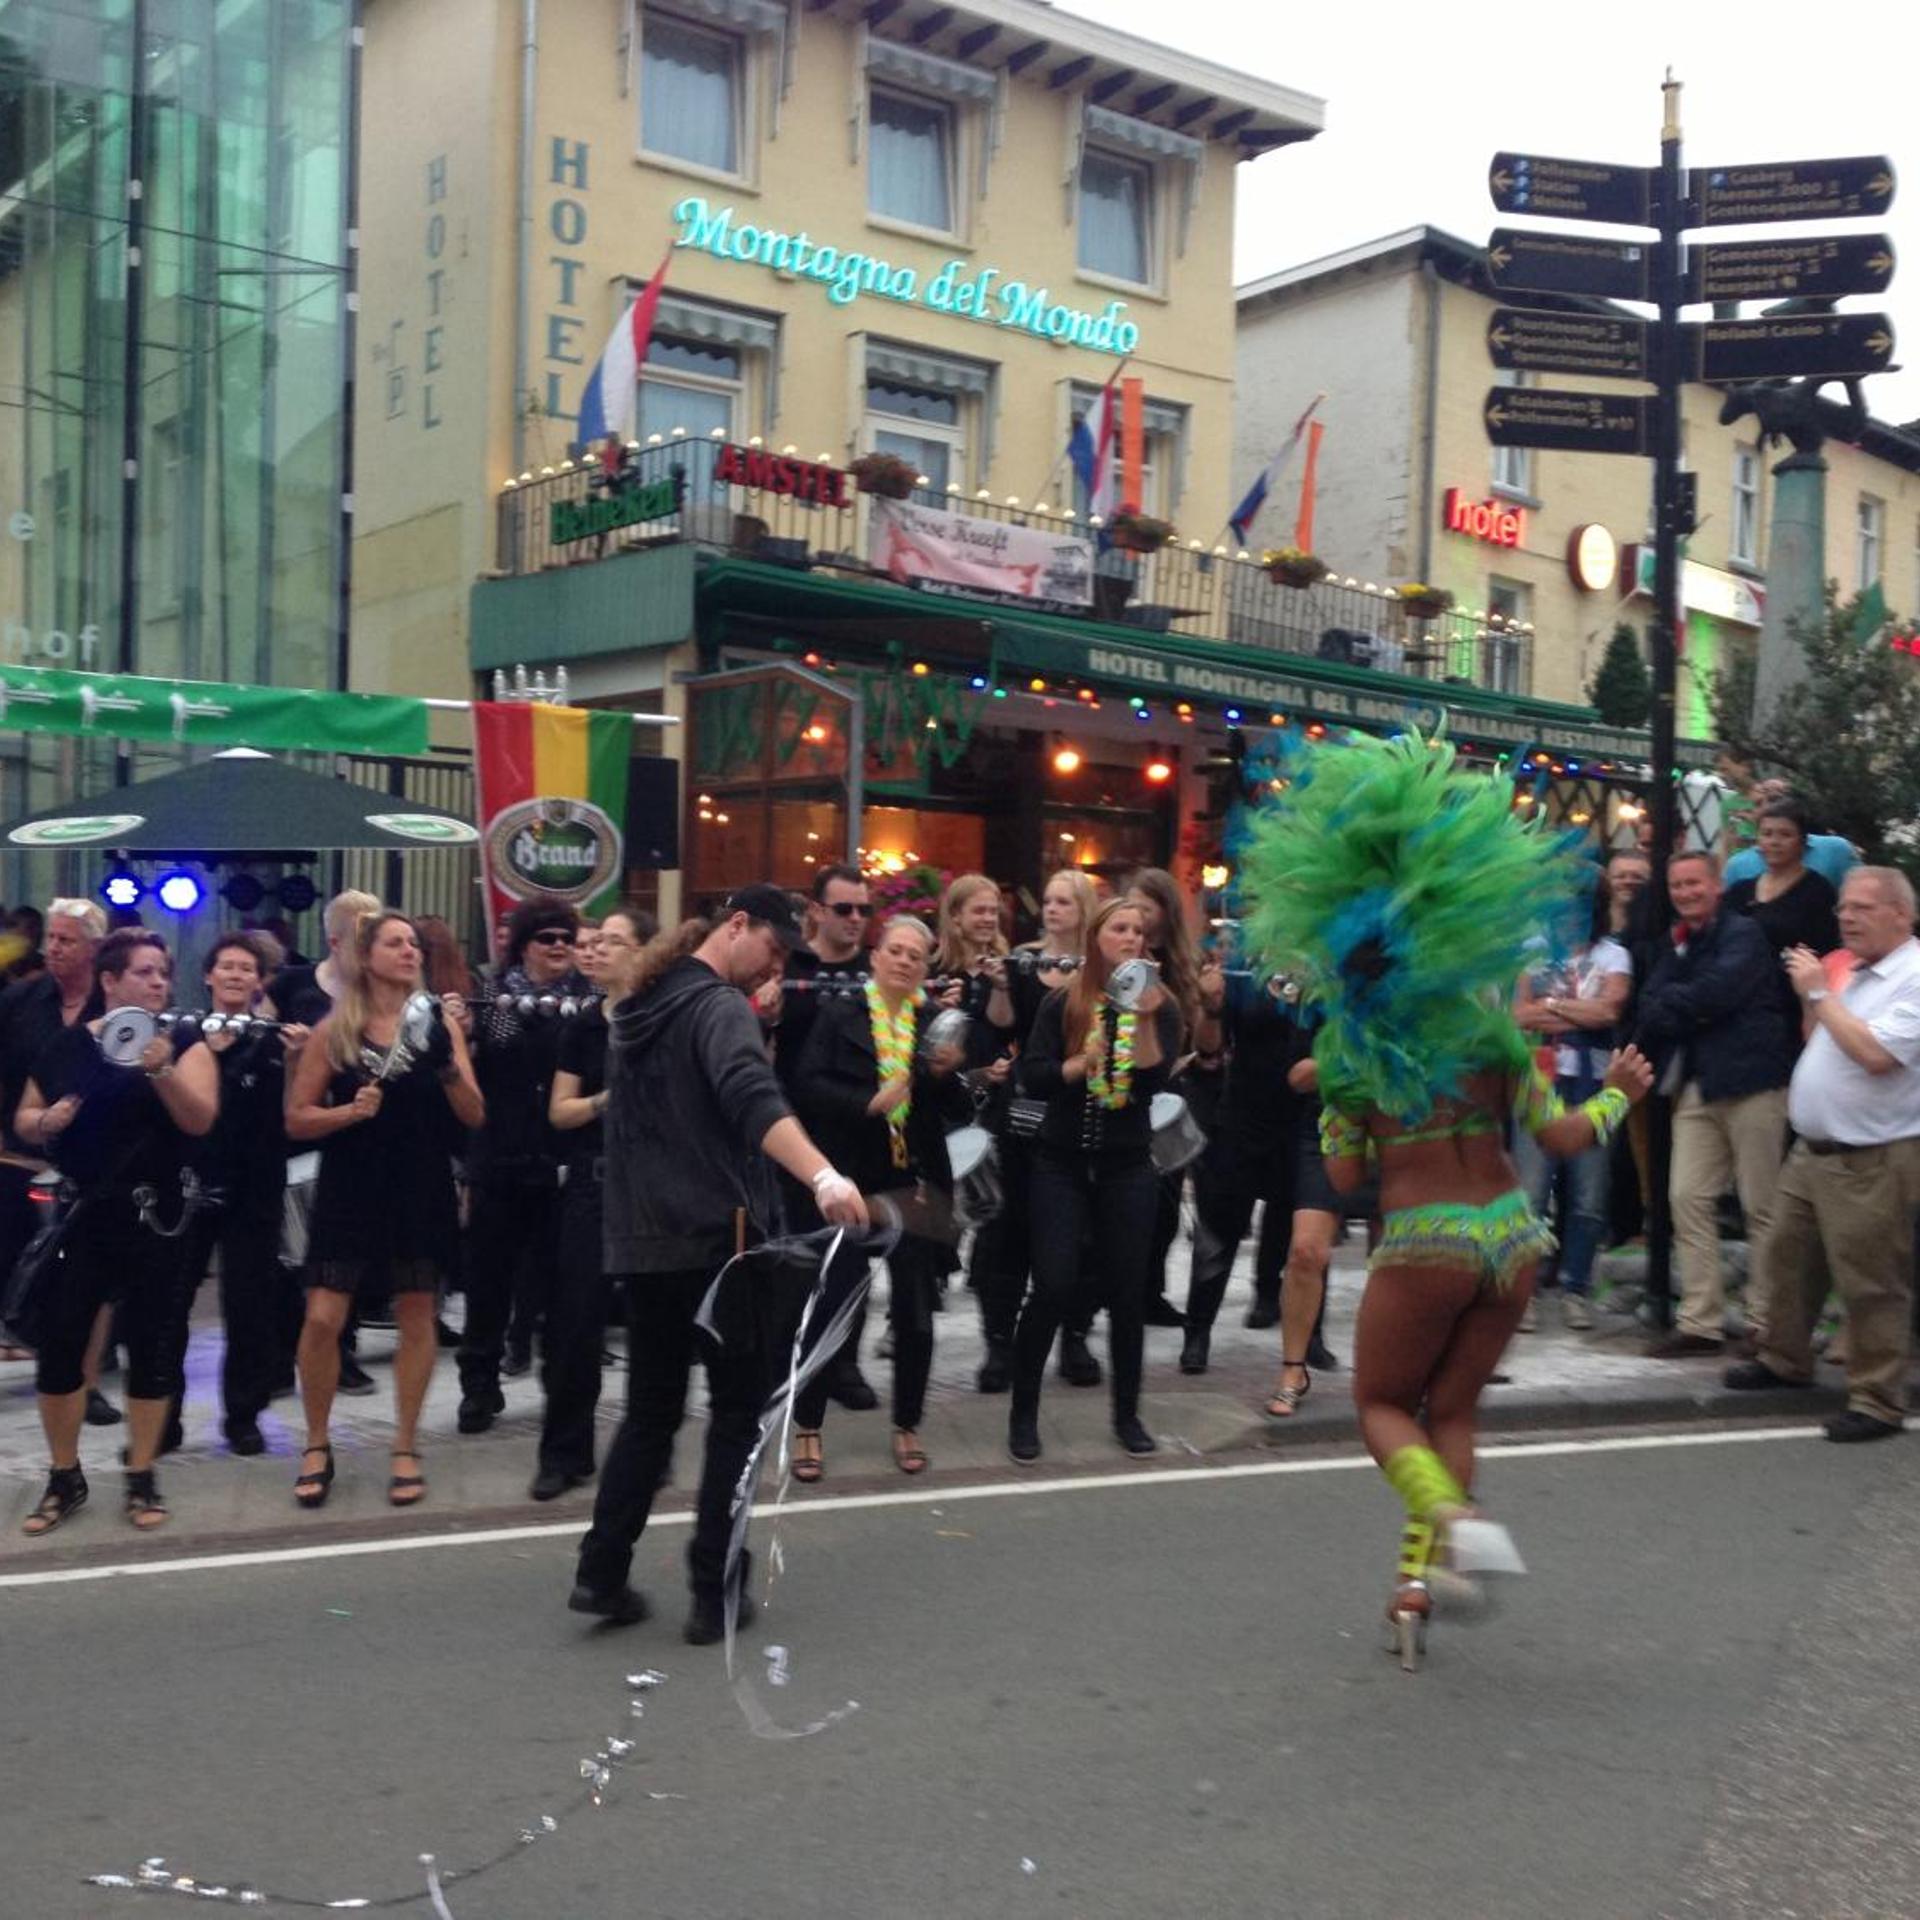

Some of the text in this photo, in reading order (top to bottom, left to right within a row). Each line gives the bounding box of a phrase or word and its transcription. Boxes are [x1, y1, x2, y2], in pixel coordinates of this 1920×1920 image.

[424, 154, 447, 431] HOTEL
[546, 136, 589, 421] HOTEL
[673, 197, 1140, 354] Montagna del Mondo
[715, 443, 856, 508] AMSTEL
[1444, 487, 1528, 548] hotel
[1088, 649, 1169, 683] HOTEL
[1174, 665, 1305, 707] MONTAGNA
[1312, 689, 1350, 714] DEL
[513, 829, 596, 872] Brand
